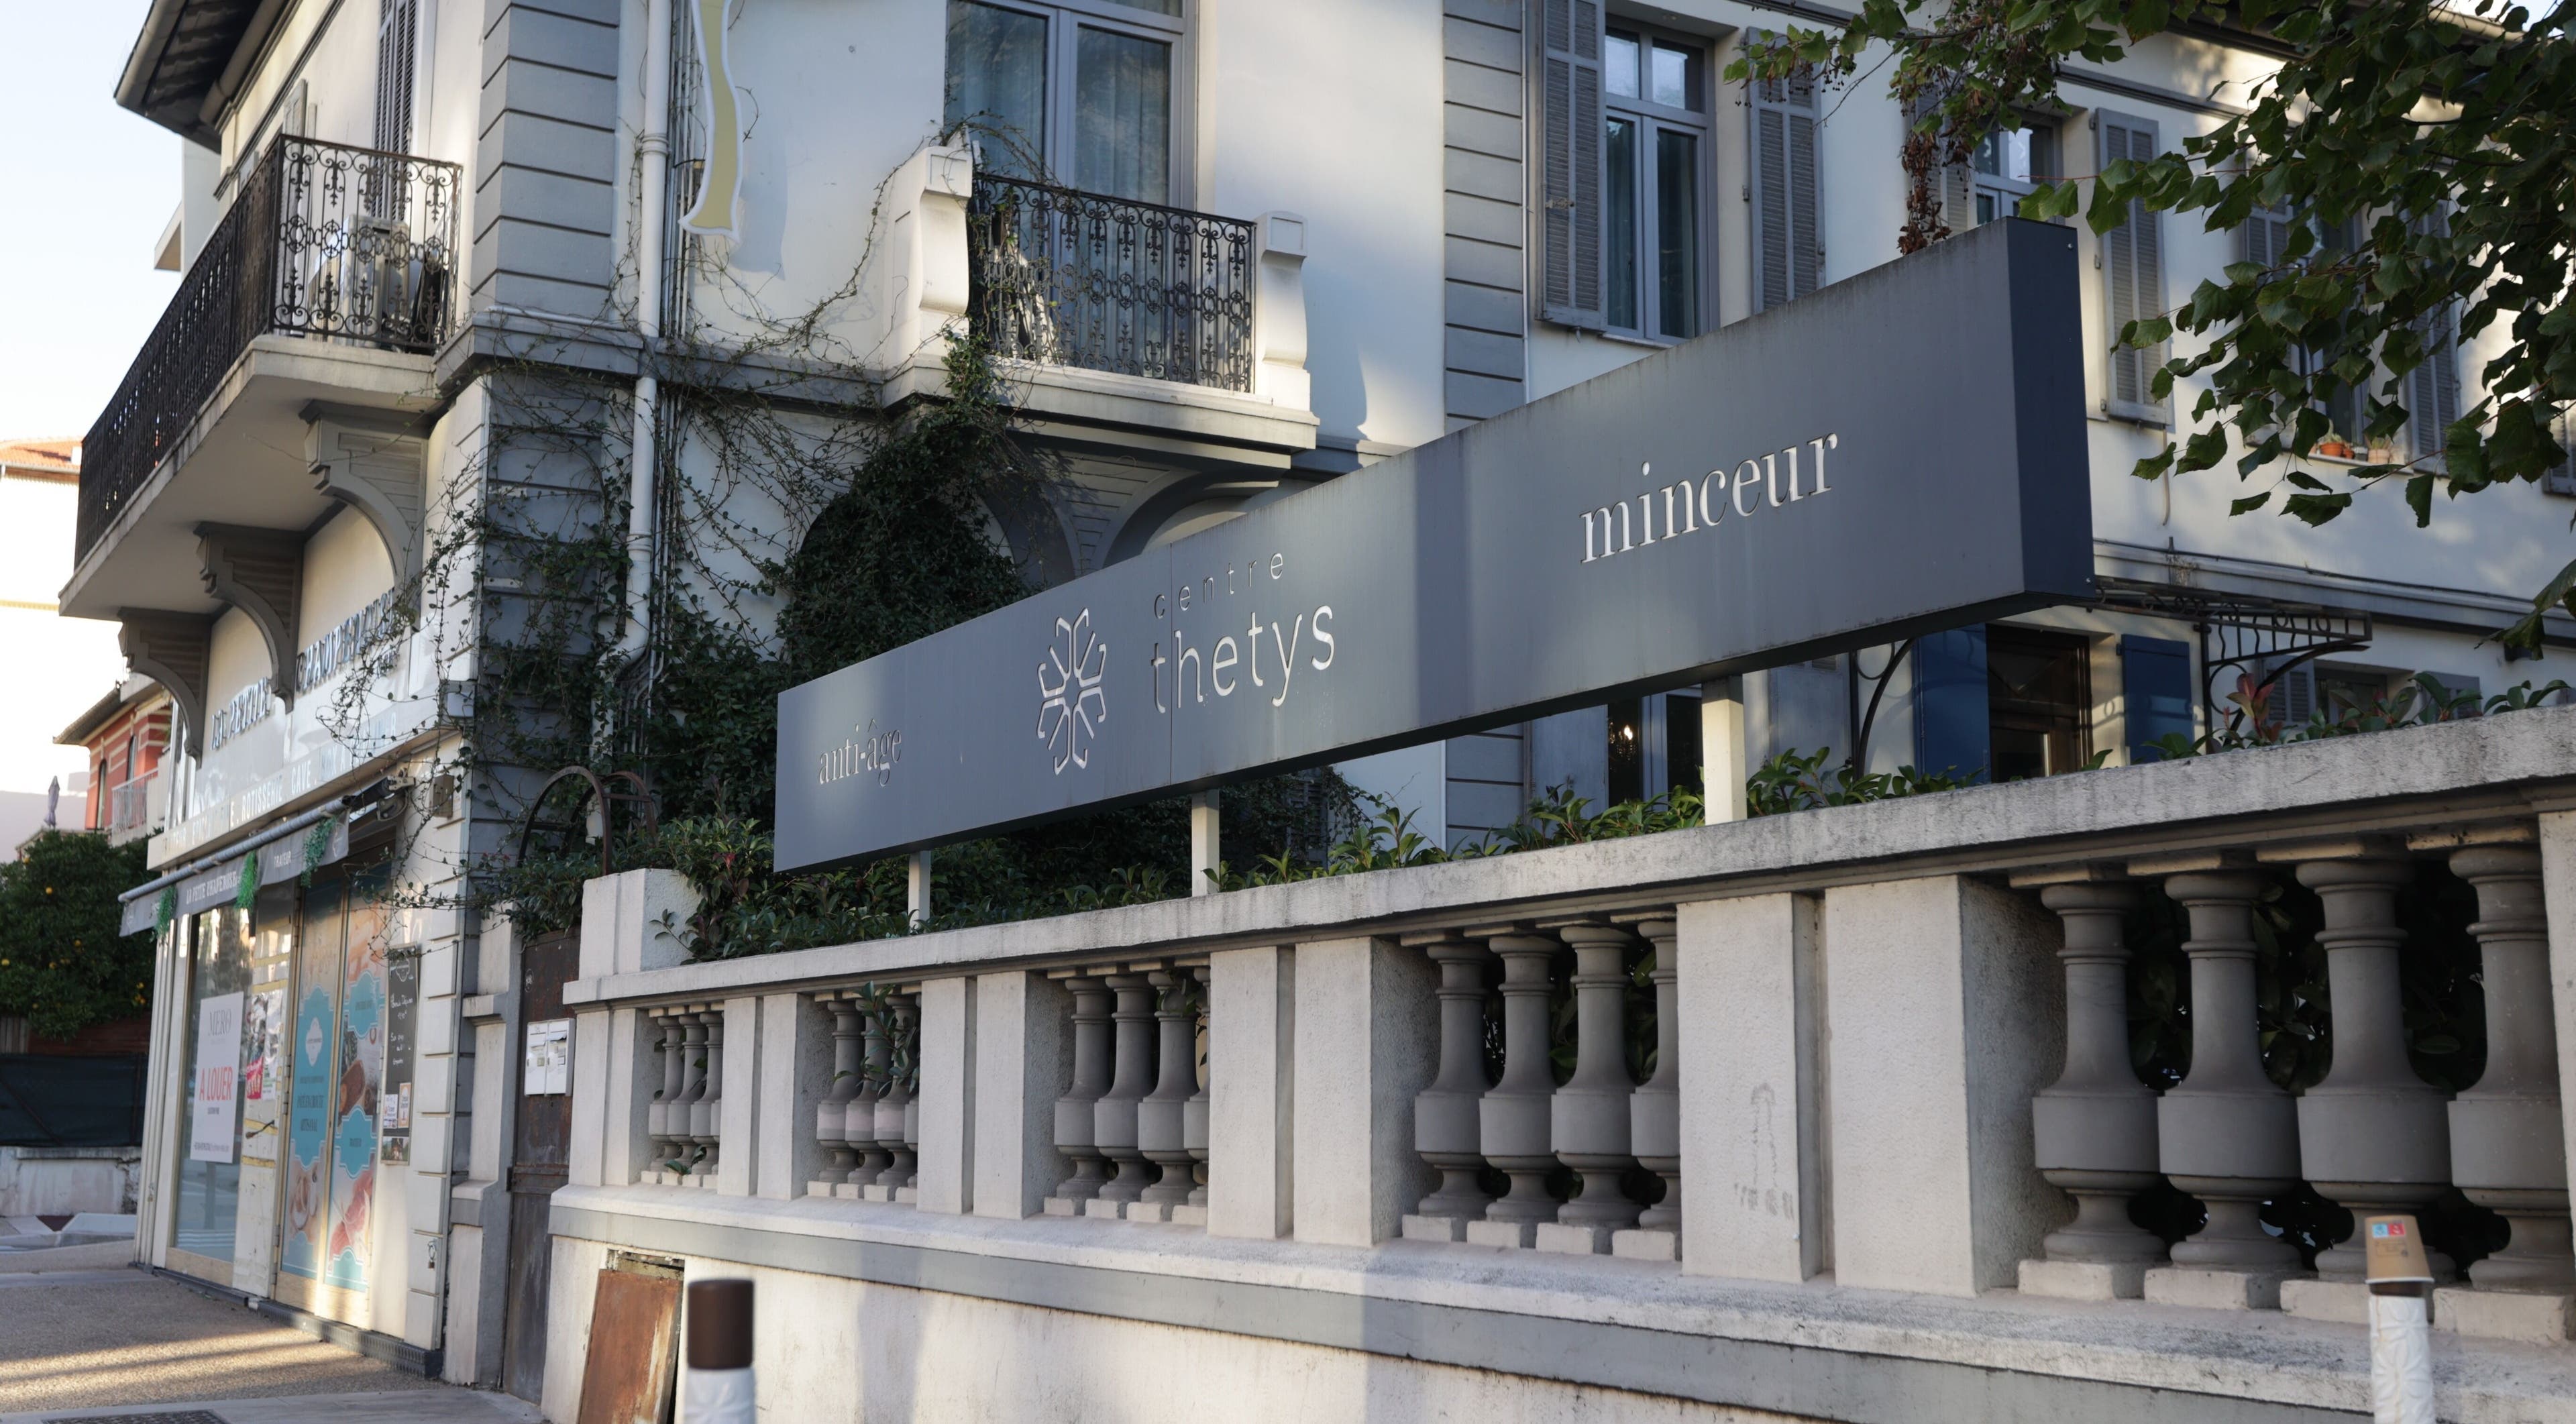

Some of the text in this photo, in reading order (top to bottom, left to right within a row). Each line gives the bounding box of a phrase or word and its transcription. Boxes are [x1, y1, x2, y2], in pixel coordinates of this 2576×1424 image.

[1580, 432, 1838, 565] minceur
[1153, 551, 1285, 620] centre
[1150, 604, 1336, 715] thetys
[818, 717, 902, 787] anti-âge
[199, 1067, 205, 1101] A
[207, 1066, 233, 1101] LOUER
